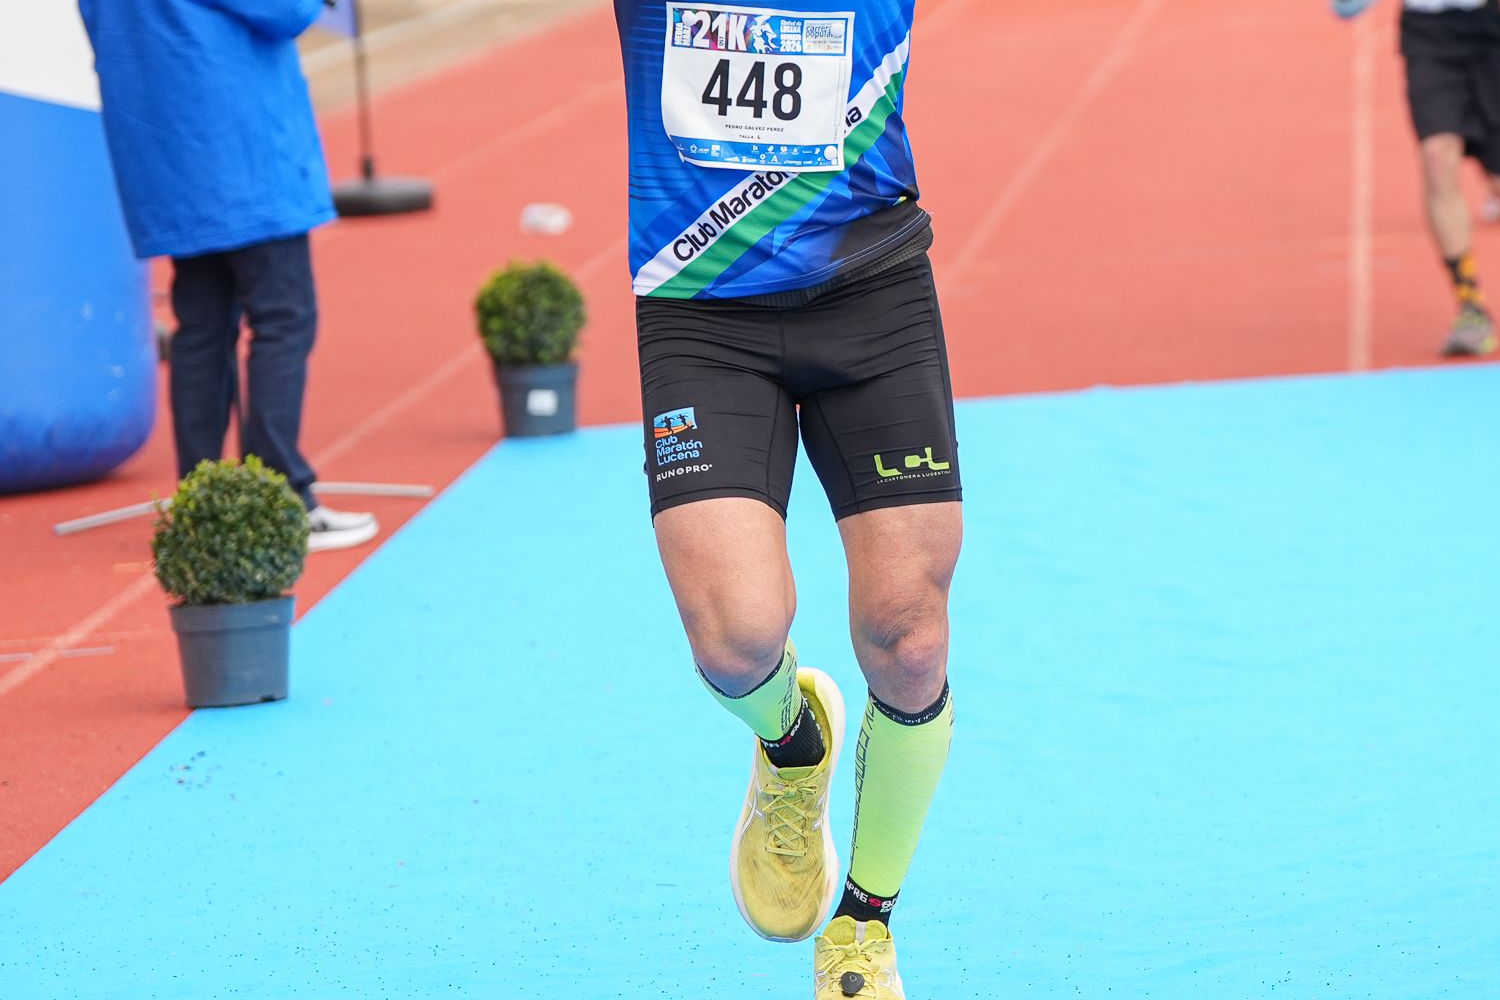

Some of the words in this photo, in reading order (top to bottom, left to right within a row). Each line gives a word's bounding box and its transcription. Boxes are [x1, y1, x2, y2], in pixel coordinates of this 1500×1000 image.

[692, 10, 748, 52] 21K
[702, 58, 802, 121] 448
[673, 222, 718, 262] Club
[655, 436, 678, 449] Club
[656, 439, 703, 458] Maratón
[657, 448, 700, 466] Lucena
